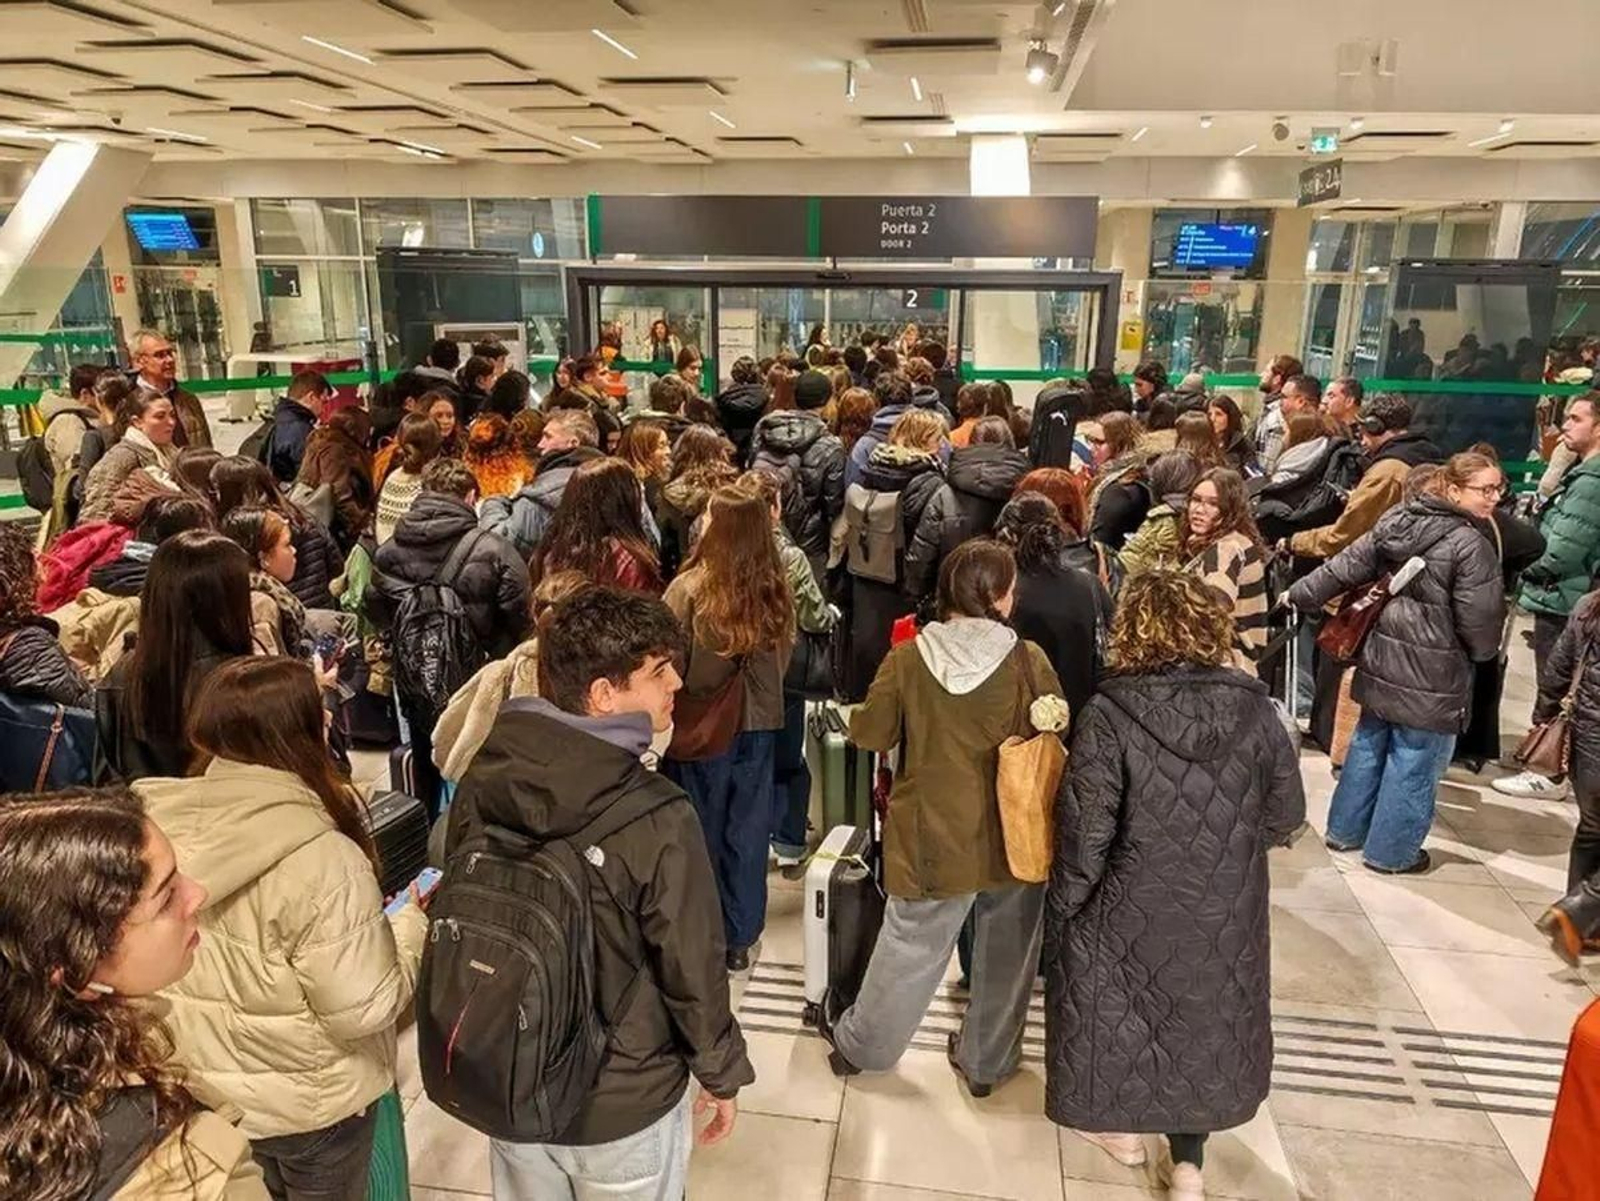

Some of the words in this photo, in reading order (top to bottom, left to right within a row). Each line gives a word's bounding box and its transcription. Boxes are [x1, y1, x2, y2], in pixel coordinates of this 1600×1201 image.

[881, 203, 923, 217] Puerta
[927, 203, 936, 217] 2
[881, 221, 917, 235] Porta
[921, 221, 929, 235] 2
[289, 280, 299, 297] 1
[906, 288, 918, 308] 2
